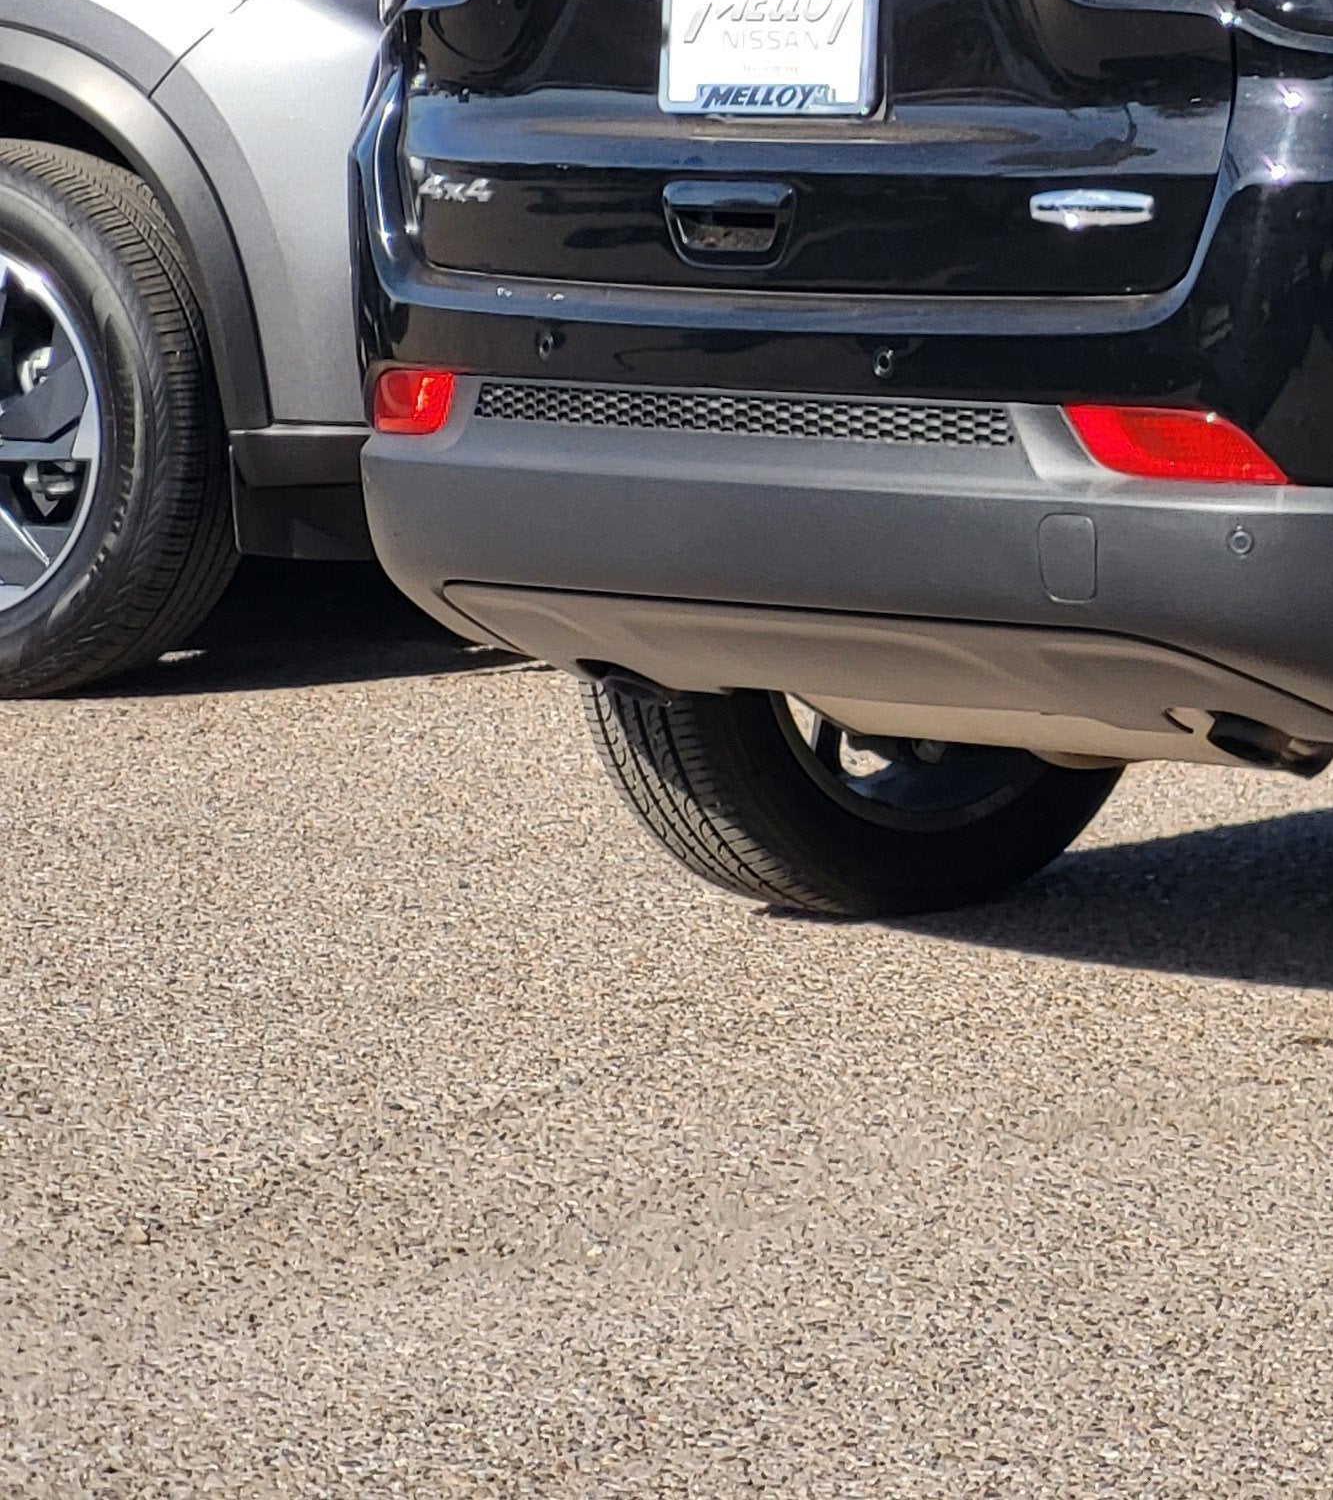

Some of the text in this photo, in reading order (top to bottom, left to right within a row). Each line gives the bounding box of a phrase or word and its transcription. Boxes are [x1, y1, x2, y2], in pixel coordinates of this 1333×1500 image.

[722, 30, 819, 50] NISSAN
[701, 84, 815, 109] MELLOY
[418, 174, 494, 203] 4x4
